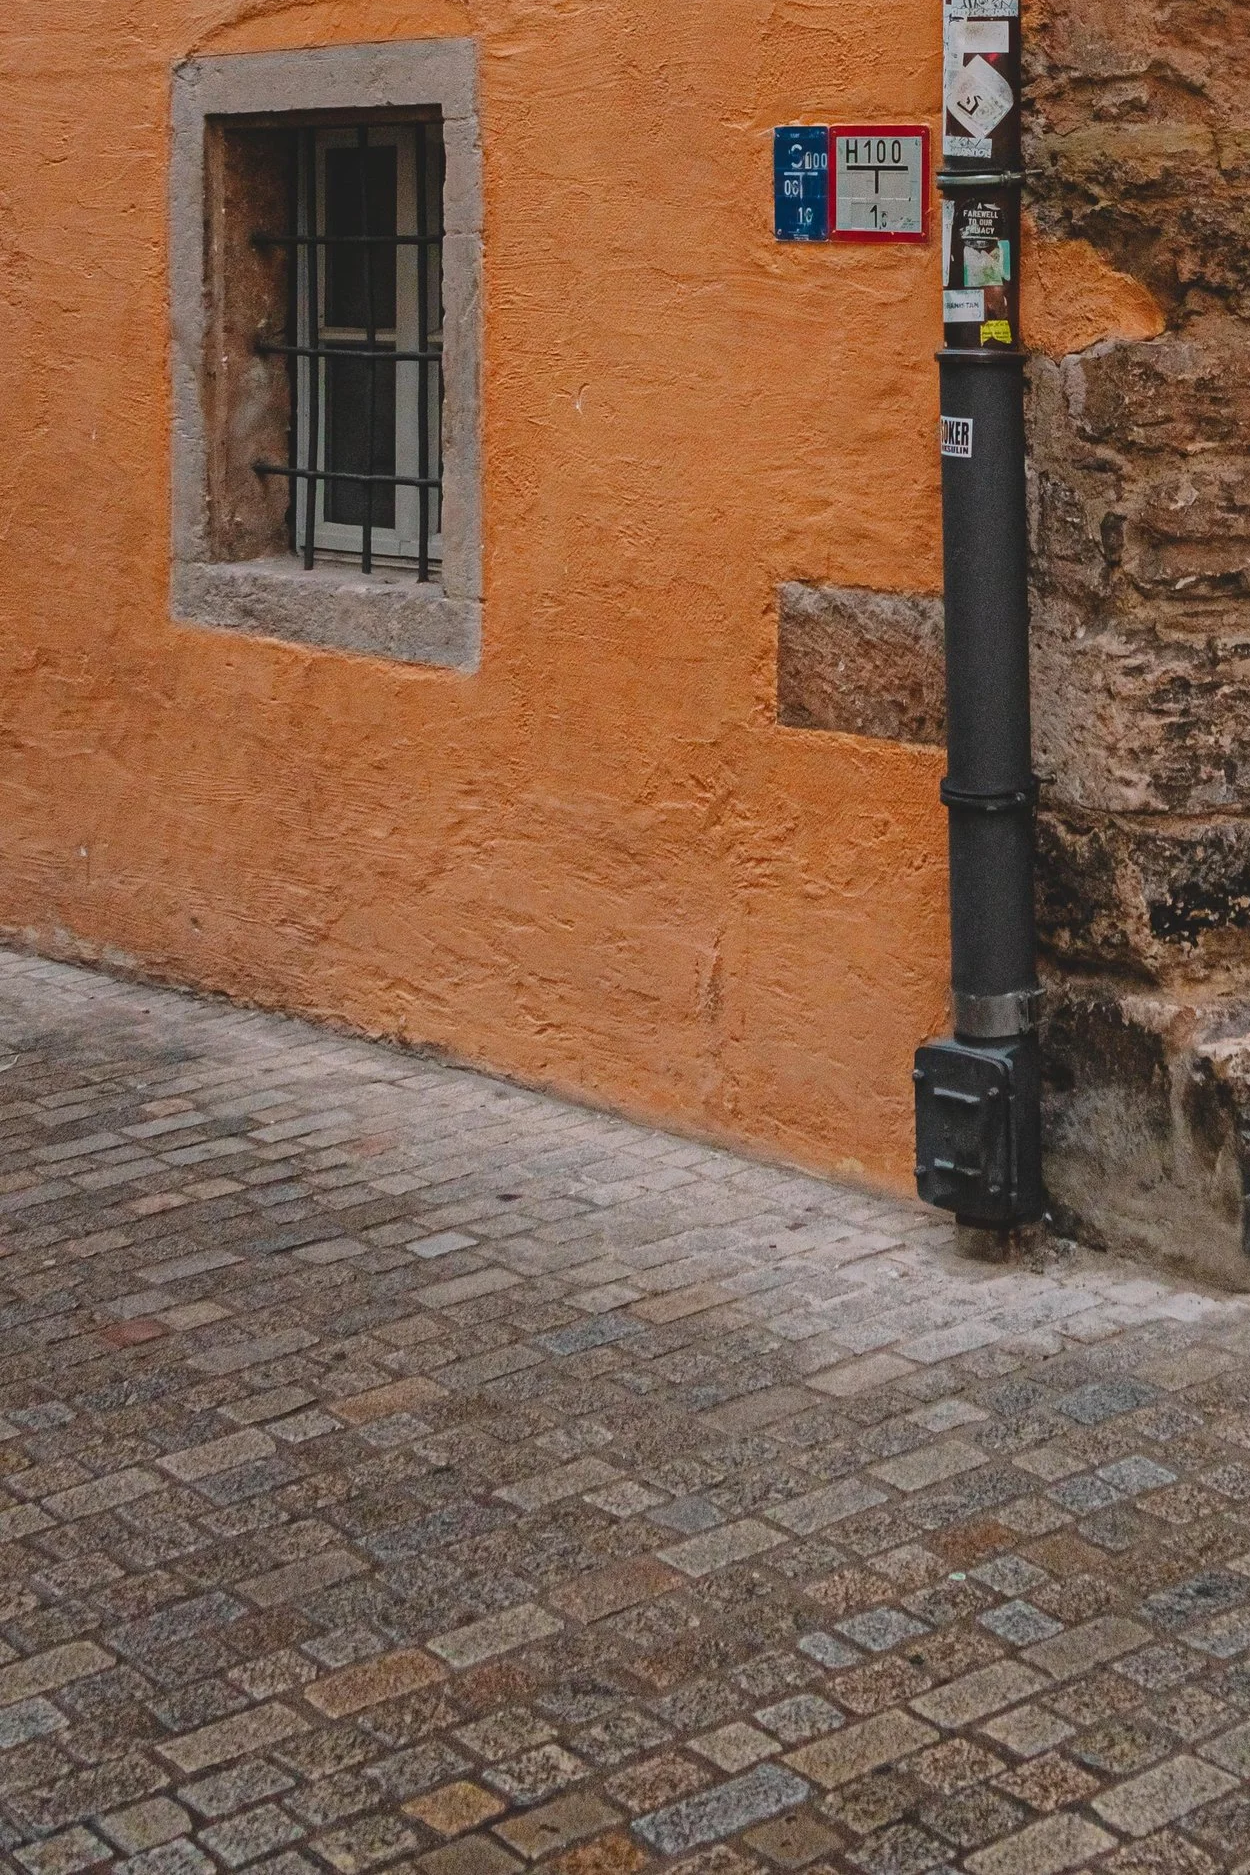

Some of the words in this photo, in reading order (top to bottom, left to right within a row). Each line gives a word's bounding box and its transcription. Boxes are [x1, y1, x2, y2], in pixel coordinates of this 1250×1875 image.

[846, 139, 901, 164] H100
[977, 202, 983, 210] A
[963, 209, 999, 219] FAREWELL
[968, 218, 977, 226] TO
